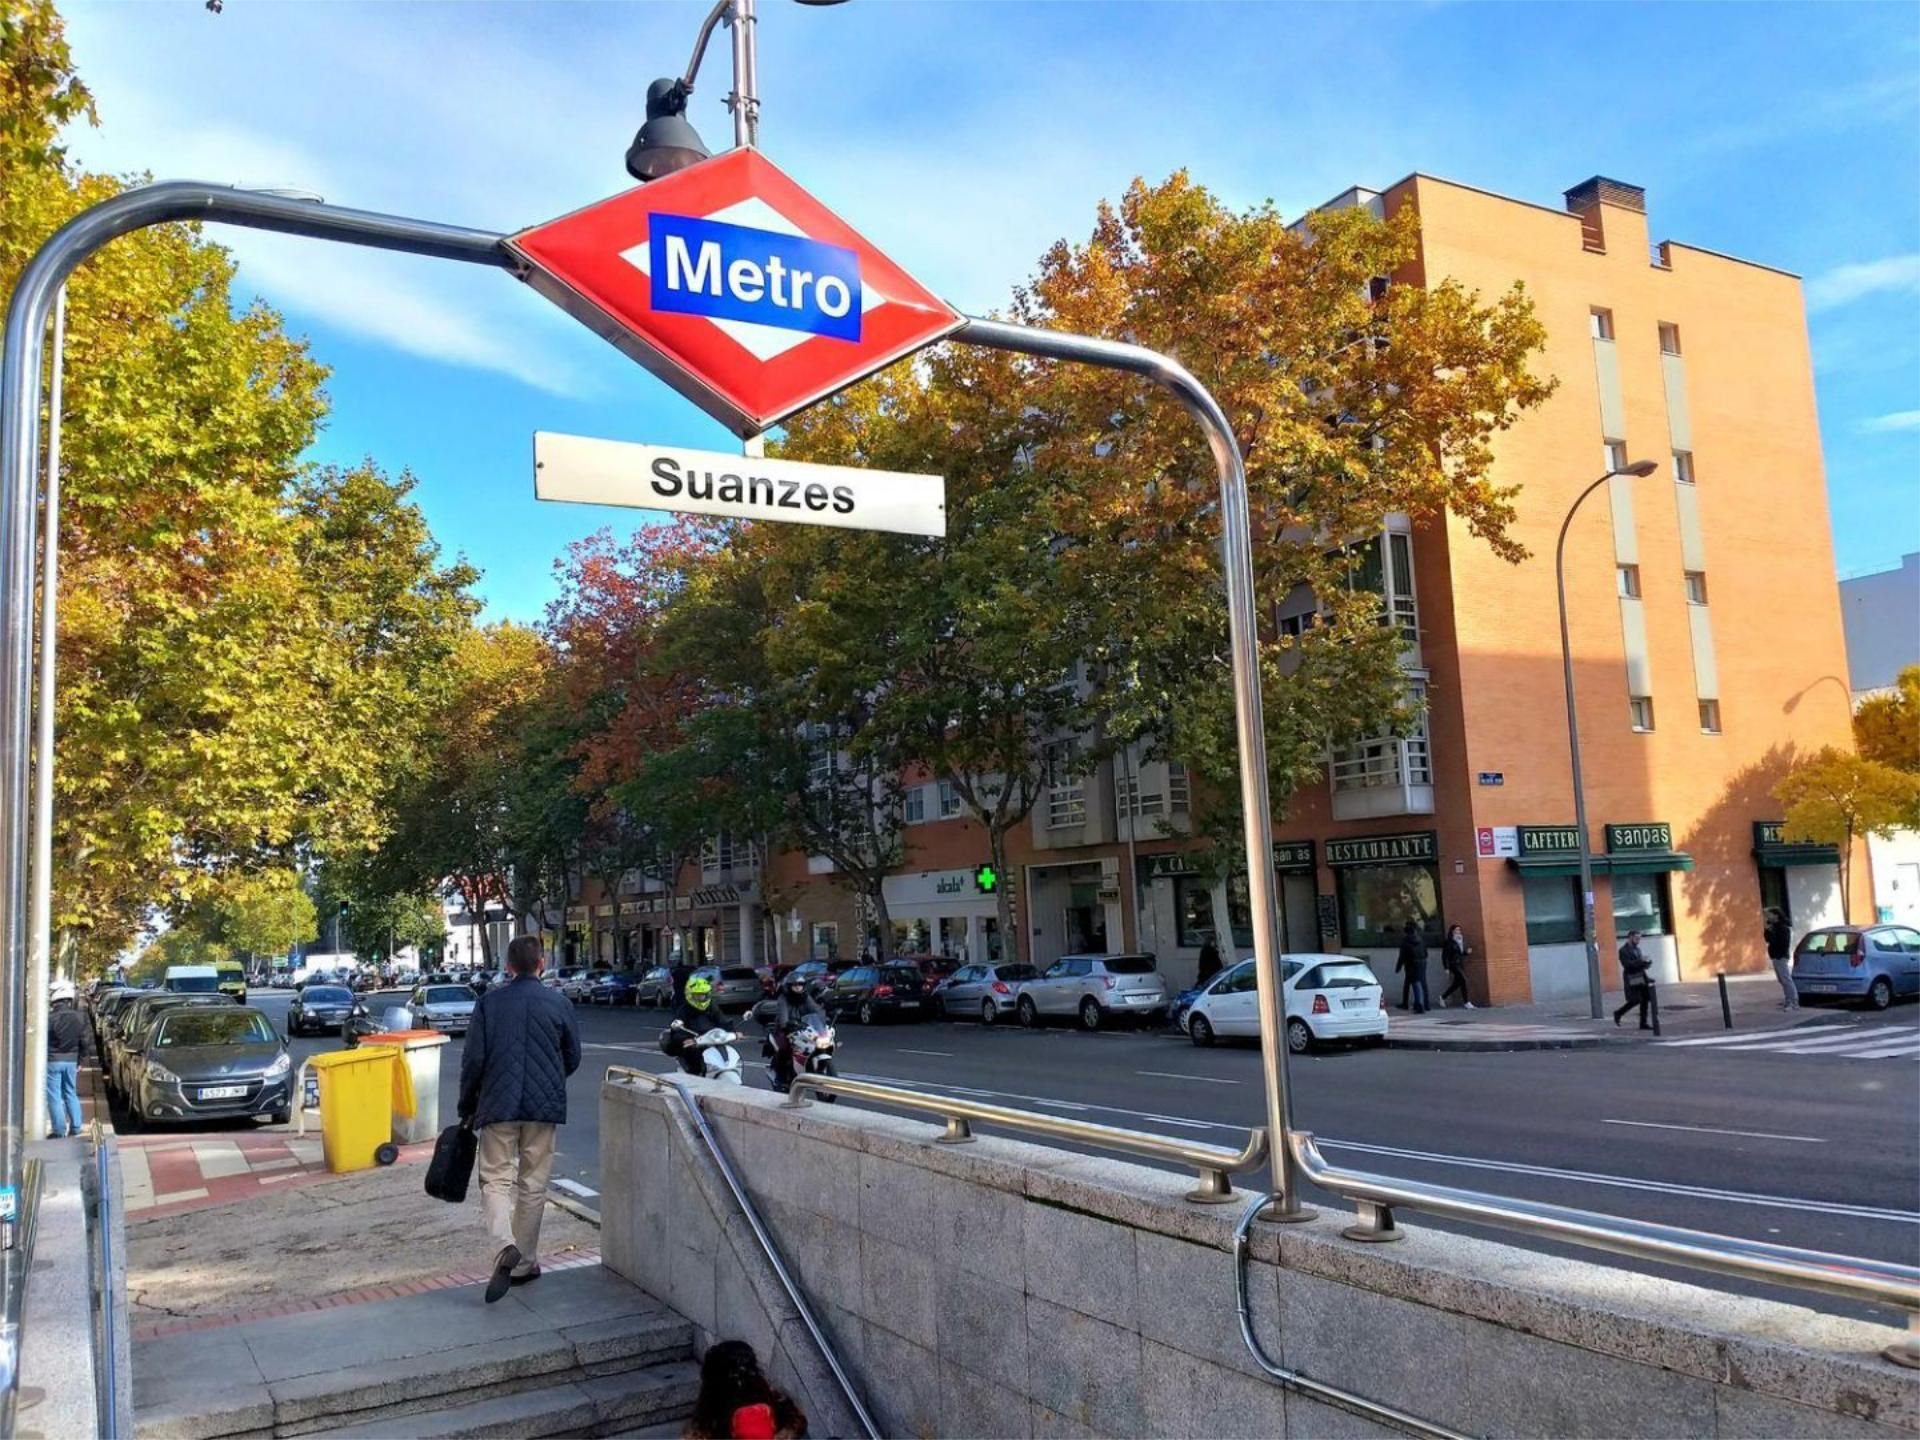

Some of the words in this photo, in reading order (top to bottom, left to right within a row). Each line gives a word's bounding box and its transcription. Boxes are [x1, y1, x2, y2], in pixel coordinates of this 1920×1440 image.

[664, 234, 852, 319] Metro
[650, 457, 856, 514] Suanzes
[1326, 838, 1432, 861] RESTAURANTE
[1524, 831, 1580, 848] CAFETERI
[1615, 828, 1669, 849] sanpas
